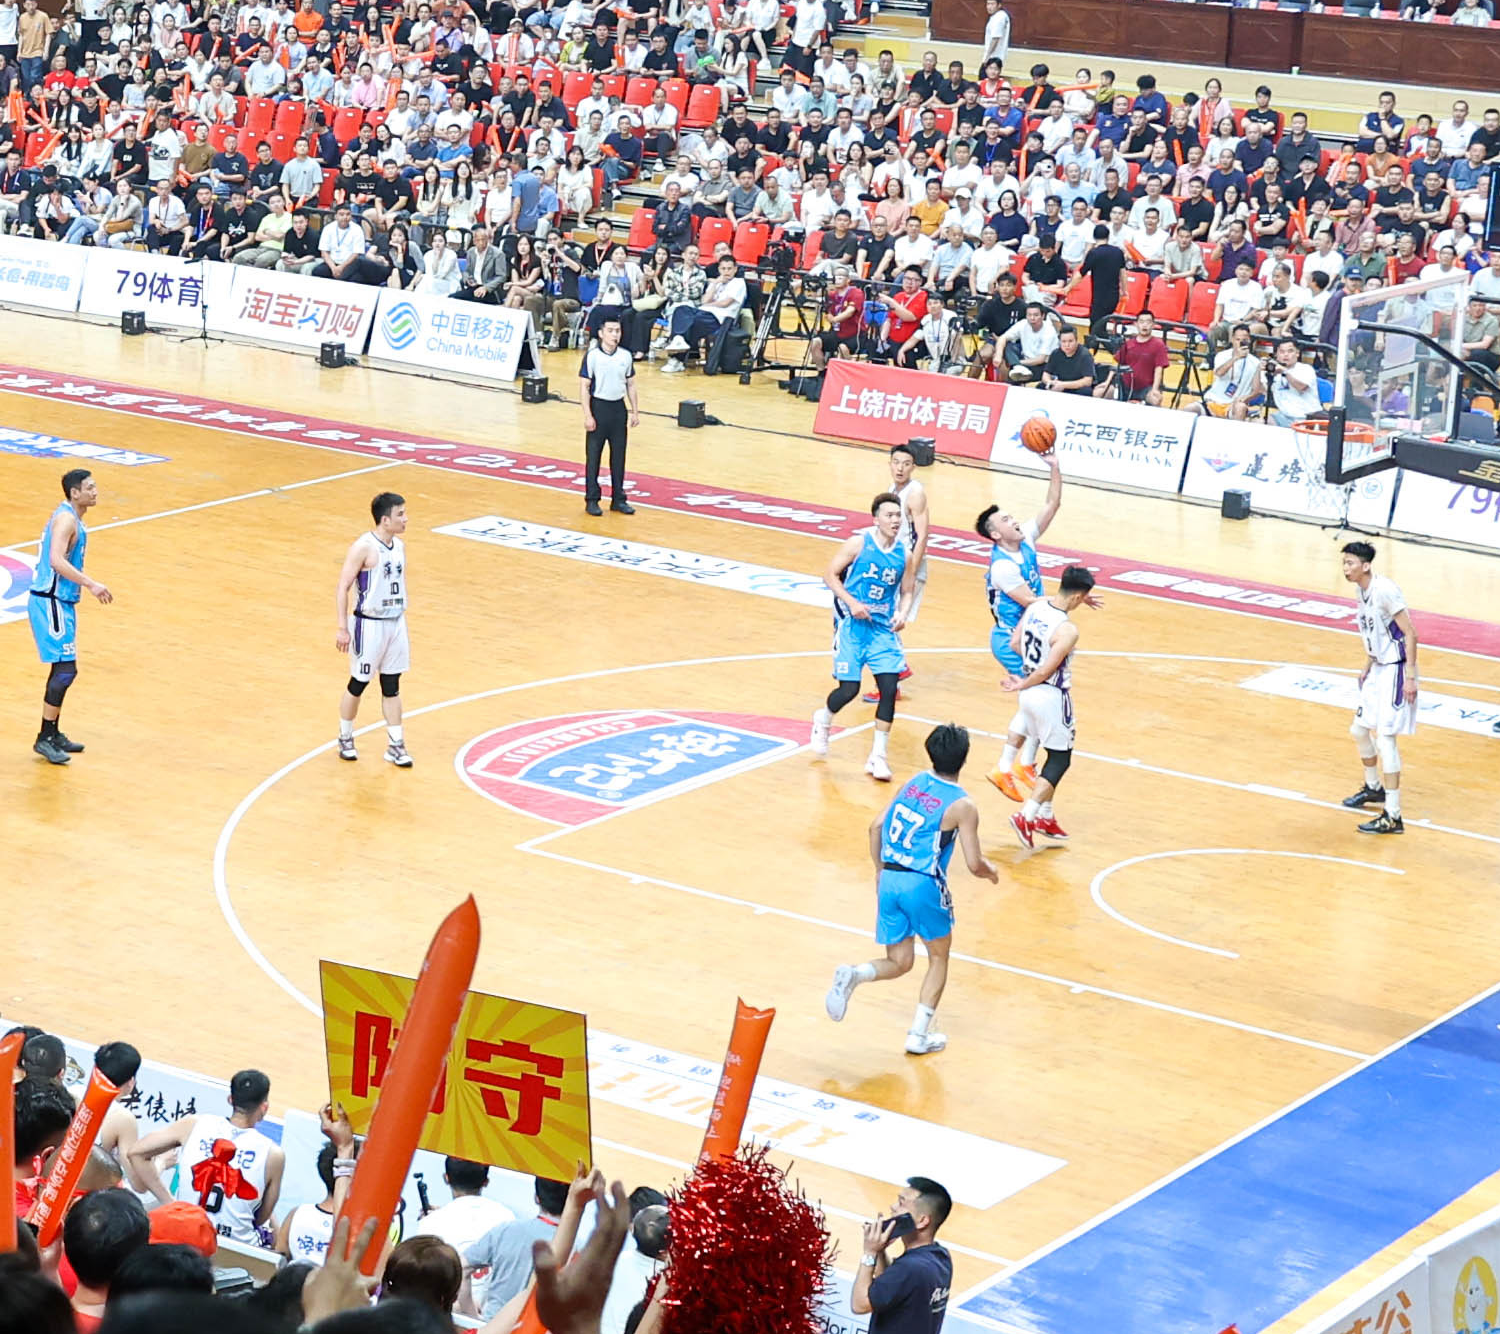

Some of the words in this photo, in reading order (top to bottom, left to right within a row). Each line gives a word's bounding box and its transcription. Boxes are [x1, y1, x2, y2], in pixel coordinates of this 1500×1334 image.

[116, 269, 203, 307] 79体育
[239, 287, 364, 338] 淘宝闪购
[431, 310, 514, 345] 中国移动
[427, 337, 461, 356] China
[466, 342, 508, 364] Mobile
[830, 384, 992, 435] 上饶市体育局
[1064, 417, 1180, 453] 江西银行
[861, 563, 897, 585] 上饶
[868, 583, 885, 600] 23
[61, 642, 76, 656] 55
[359, 662, 371, 675] 10
[888, 802, 928, 850] 67
